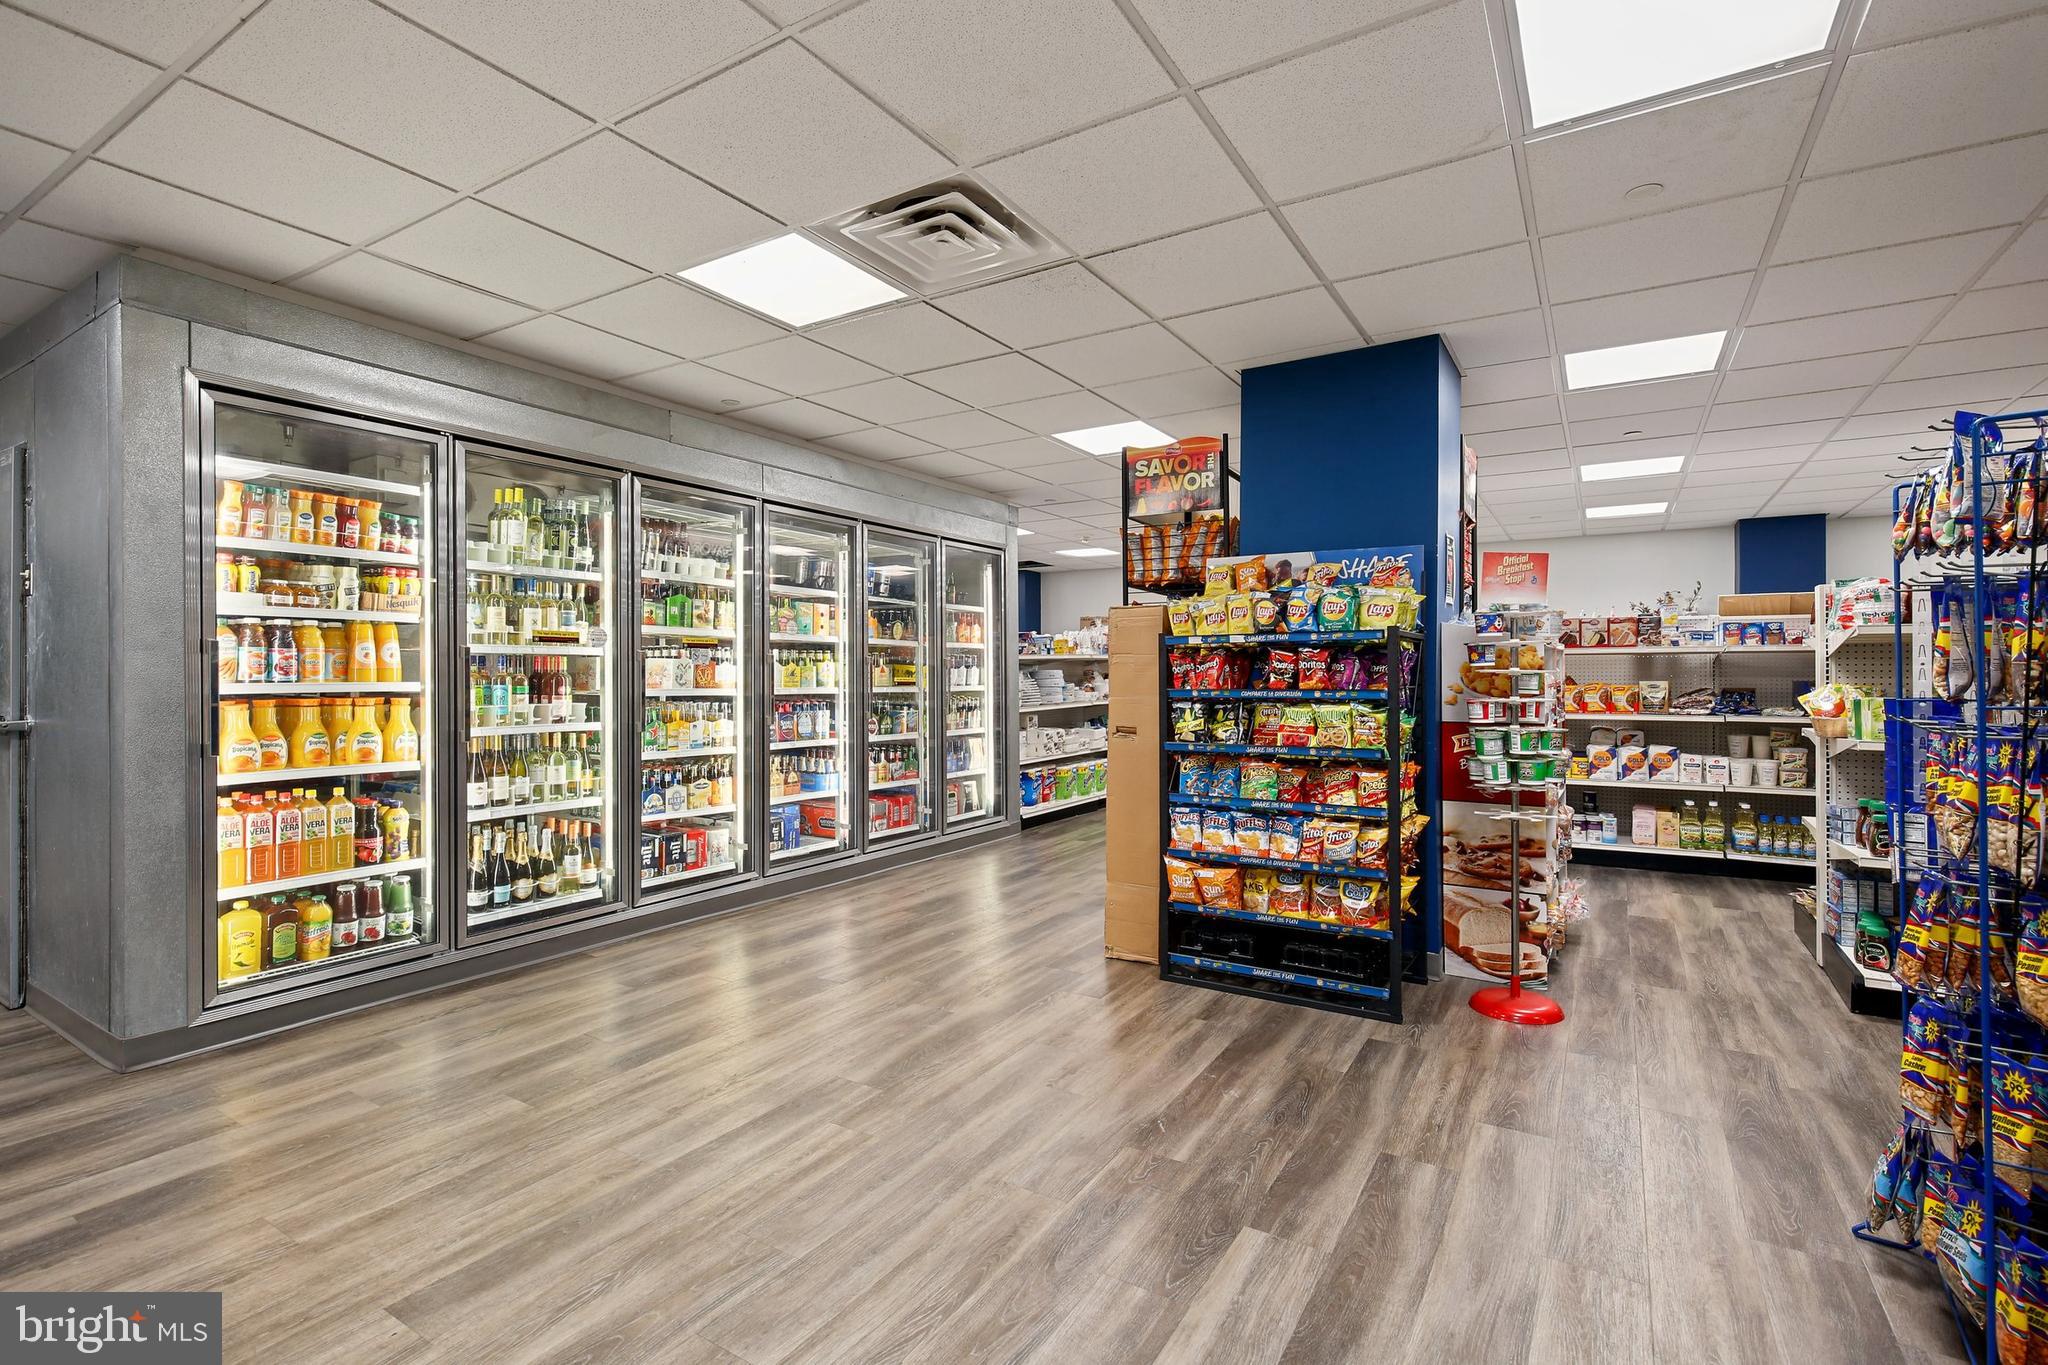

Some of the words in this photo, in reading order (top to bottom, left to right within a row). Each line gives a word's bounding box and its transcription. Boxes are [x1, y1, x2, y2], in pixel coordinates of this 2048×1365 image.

[1135, 453, 1206, 477] SAVOR
[1135, 471, 1215, 496] FLAVOR
[1503, 554, 1529, 566] Official
[1497, 562, 1534, 576] Breakfast
[1504, 573, 1525, 585] Stop!
[386, 599, 420, 609] Nesquik
[250, 820, 271, 828] ALOE
[280, 816, 299, 825] ALOE
[305, 820, 326, 829] VERA
[334, 817, 353, 825] VERA
[249, 827, 271, 836] VERA
[280, 824, 300, 832] VERA
[1326, 829, 1353, 844] Fritos
[641, 846, 652, 865] Lite
[670, 841, 681, 860] Lite
[1903, 1059, 1927, 1072] Cashews
[2010, 1081, 2023, 1095] 99
